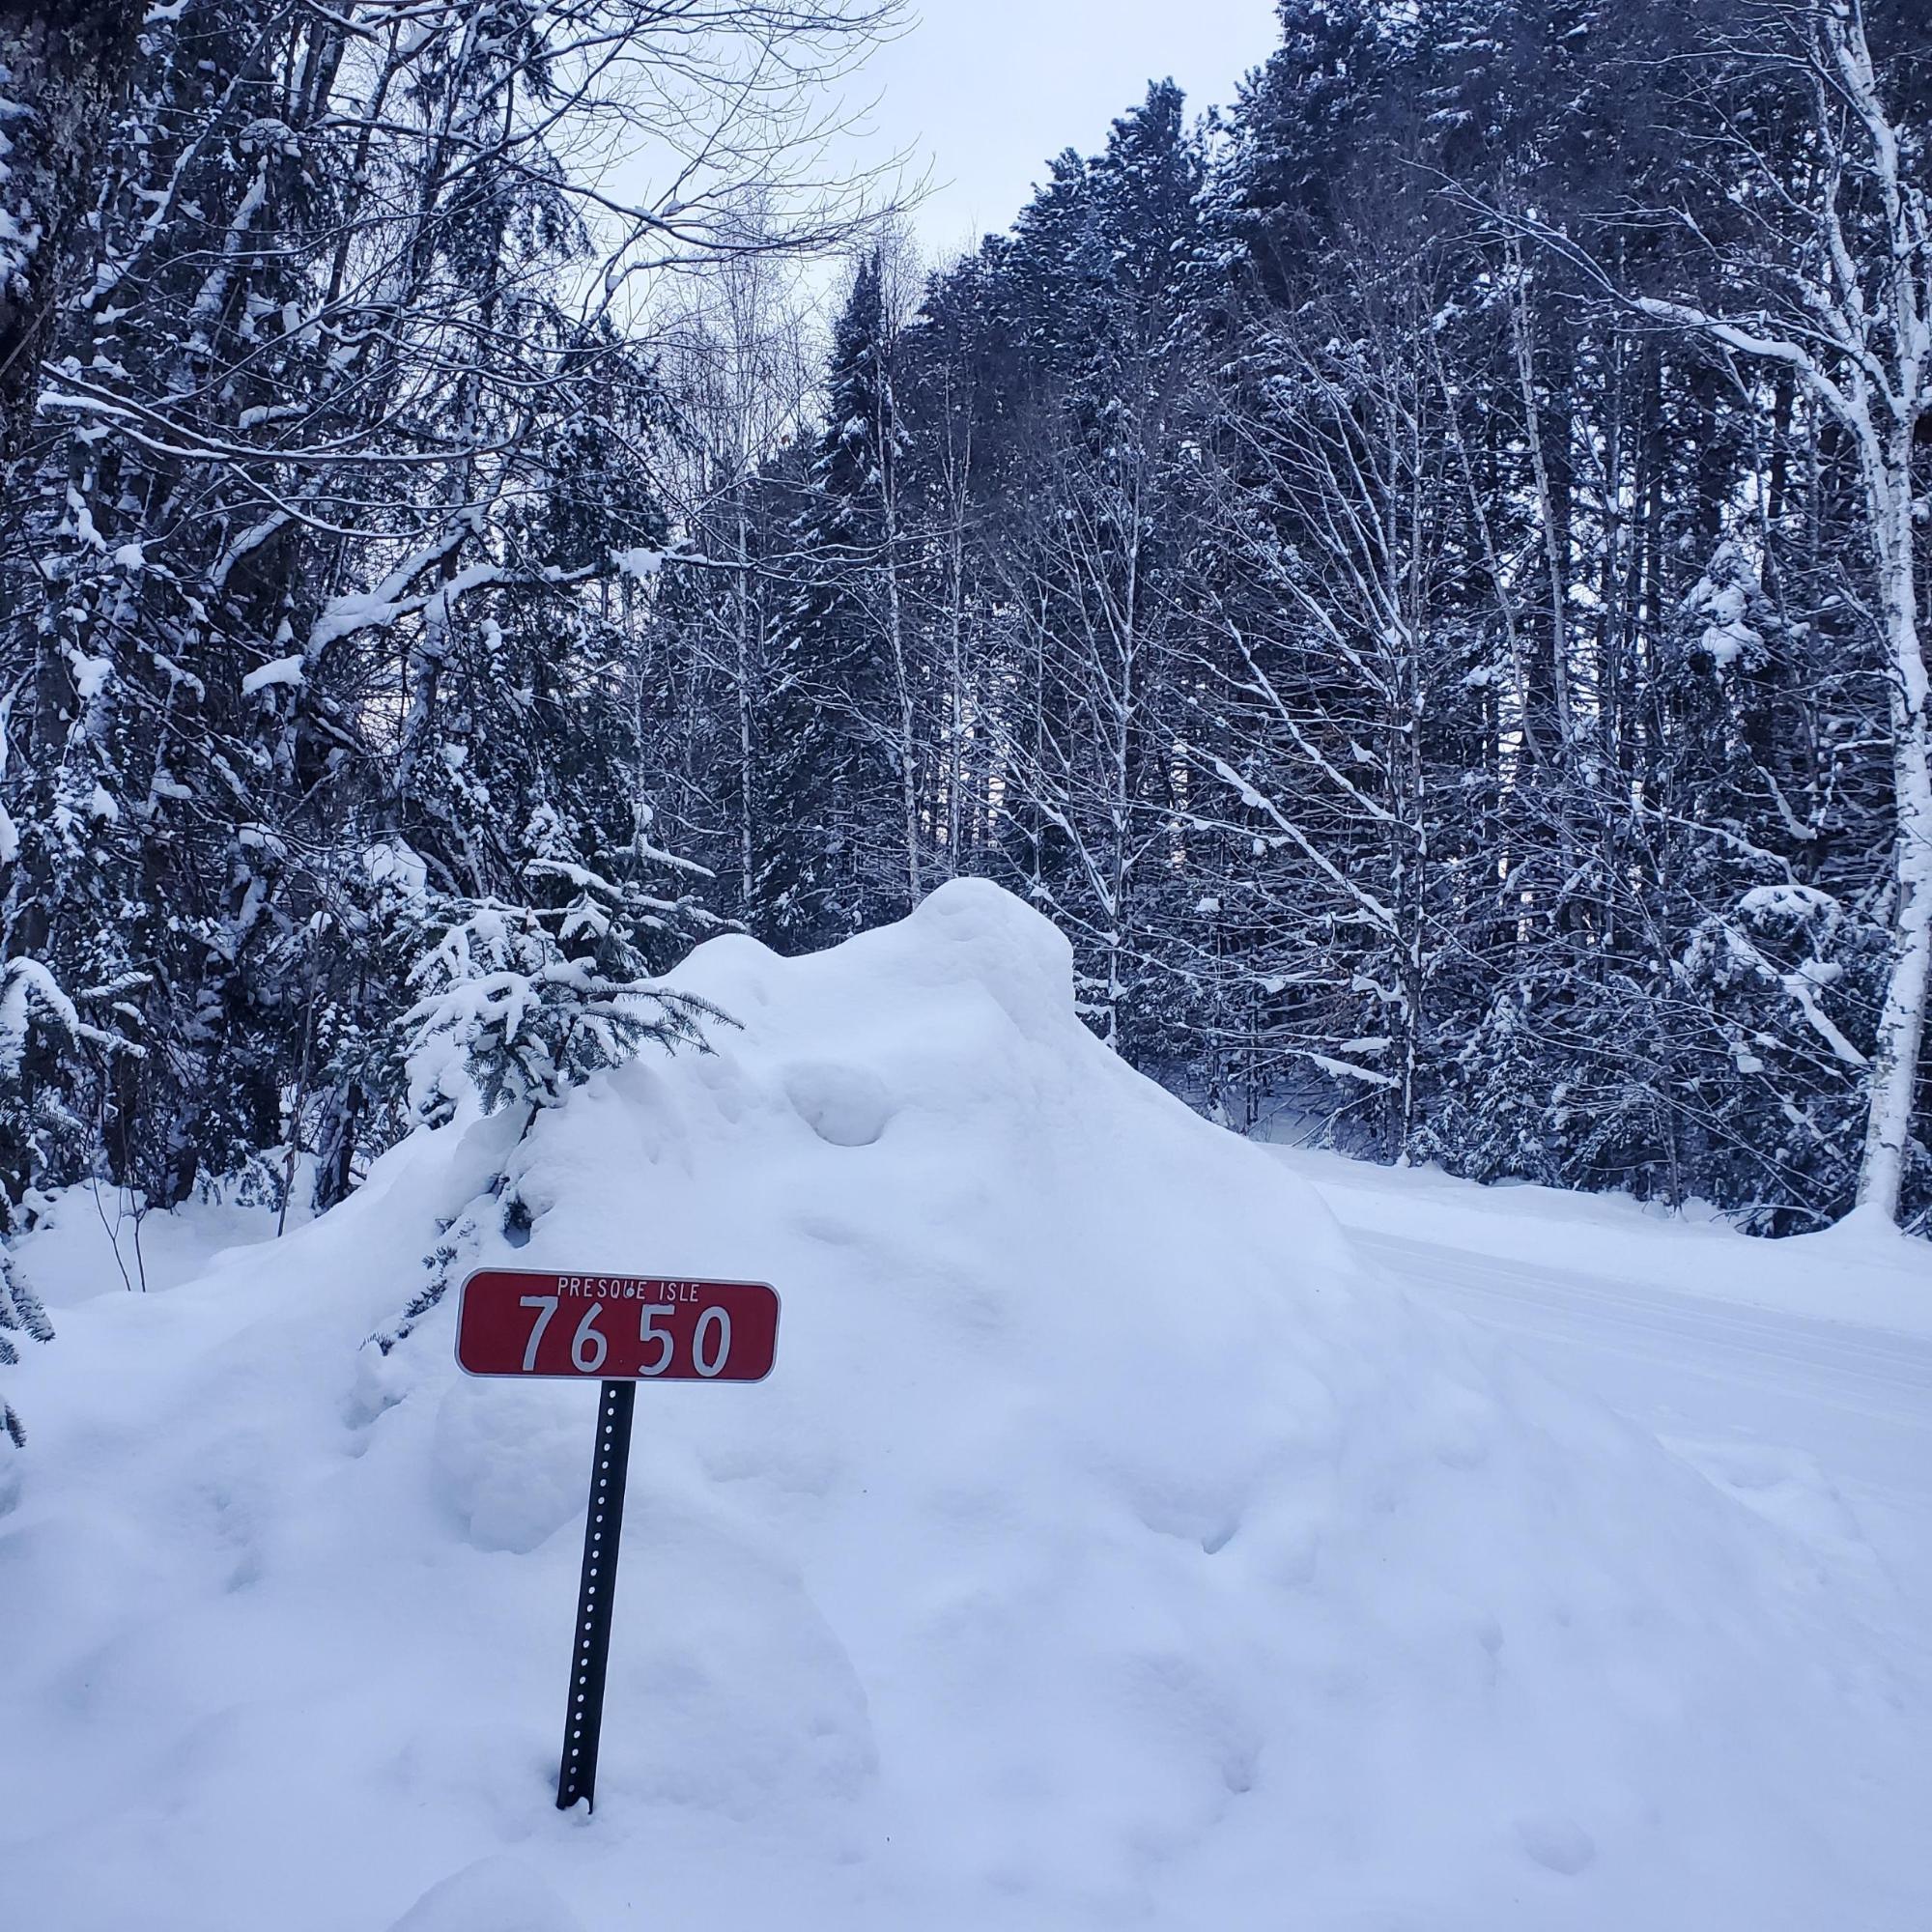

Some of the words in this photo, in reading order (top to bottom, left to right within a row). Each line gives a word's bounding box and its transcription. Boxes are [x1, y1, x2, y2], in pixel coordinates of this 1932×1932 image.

[557, 1277, 647, 1300] PRESQUE
[659, 1282, 700, 1302] ISLE
[520, 1295, 731, 1378] 7650
